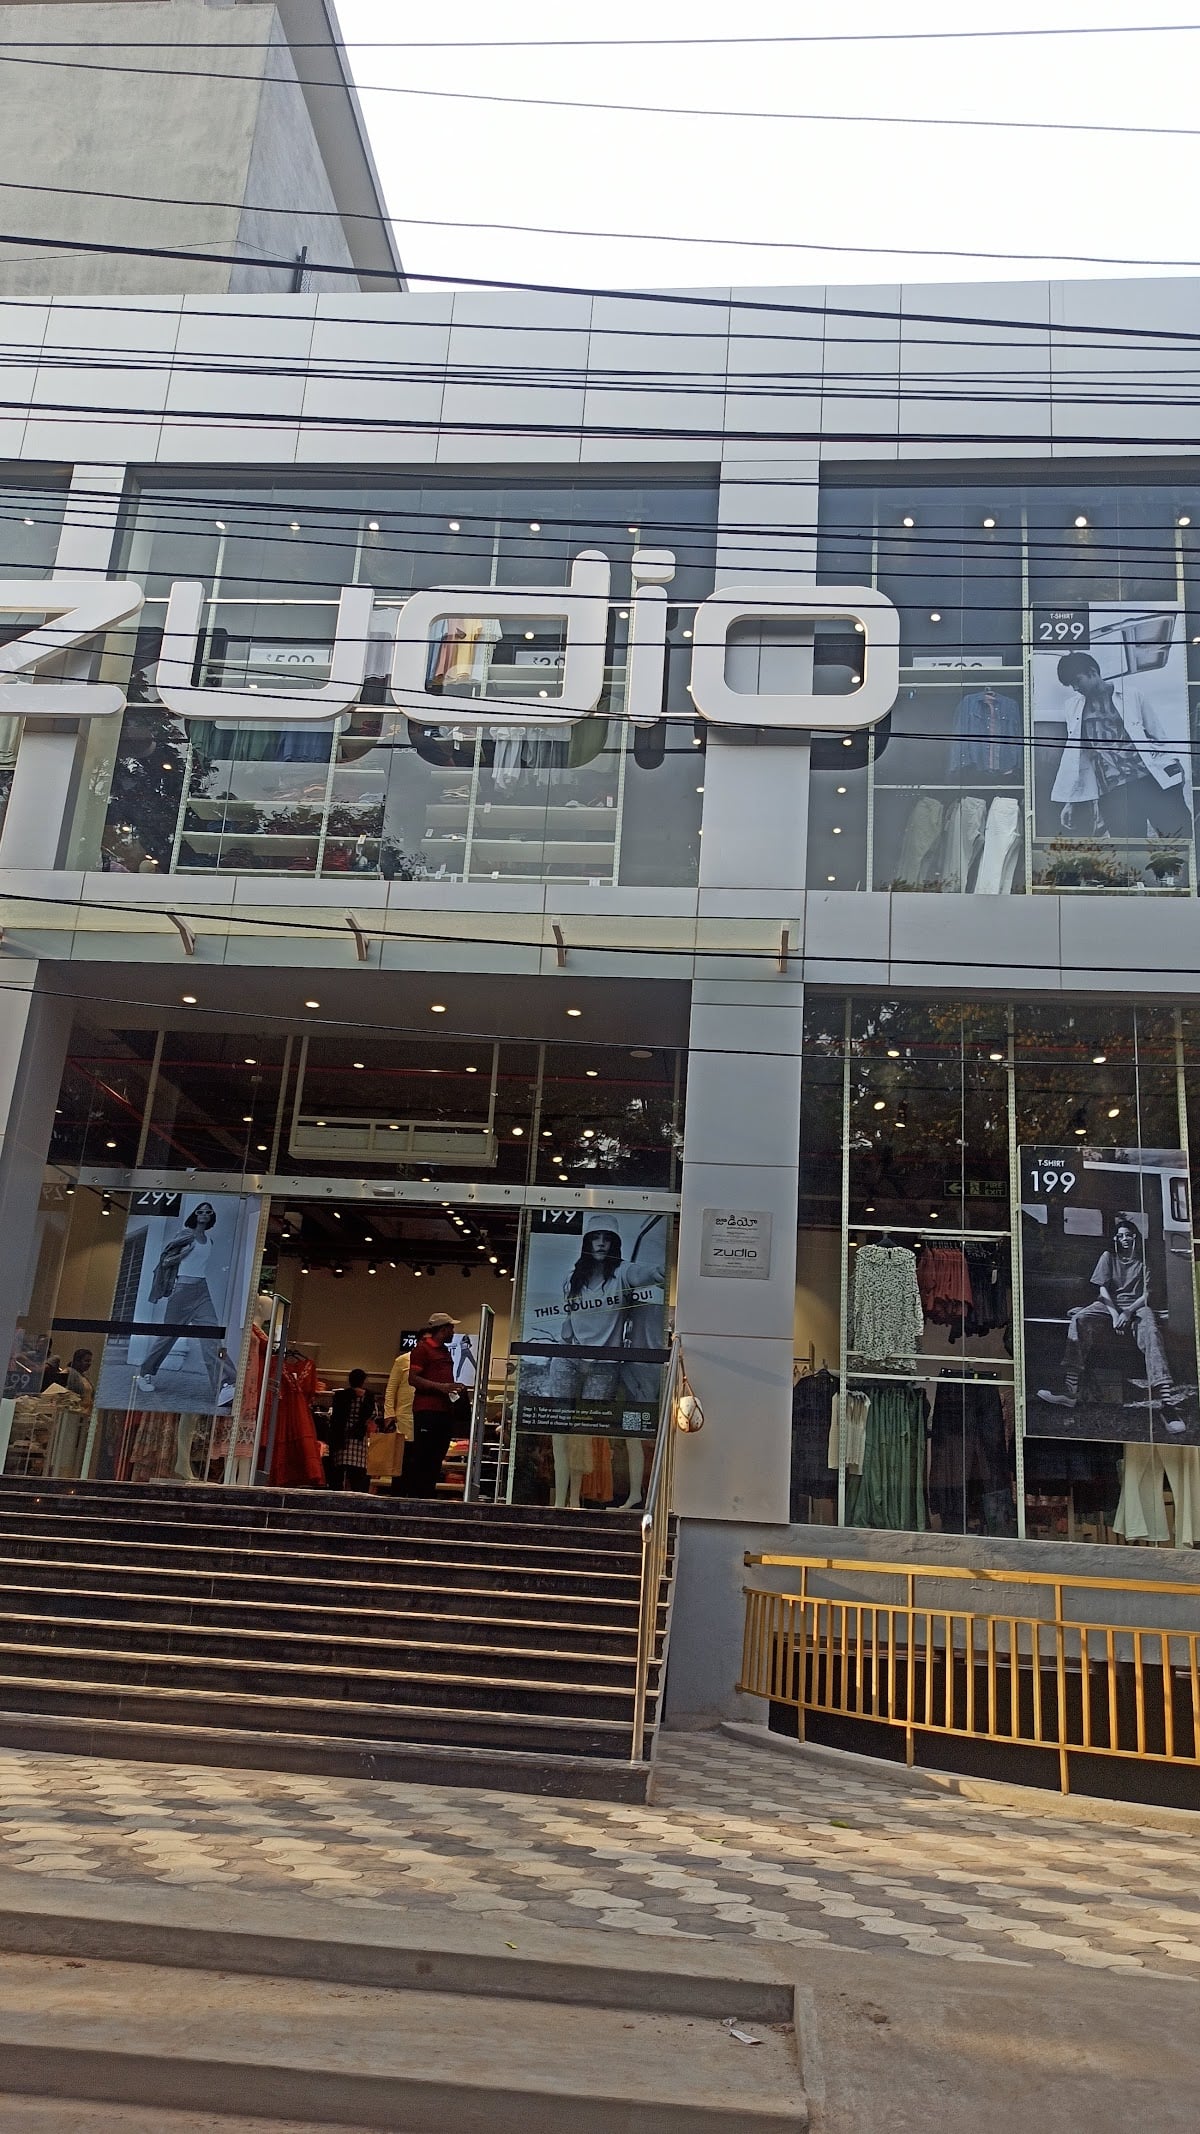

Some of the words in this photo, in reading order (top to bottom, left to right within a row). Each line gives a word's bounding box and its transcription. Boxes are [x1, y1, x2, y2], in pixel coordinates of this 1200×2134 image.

[1039, 622, 1085, 641] 299
[1038, 1159, 1065, 1168] T-SHIRT
[1031, 1170, 1076, 1194] 199
[136, 1191, 178, 1206] 299
[542, 1209, 577, 1224] 199
[534, 1305, 560, 1319] THIS
[563, 1298, 603, 1314] COULD
[606, 1295, 621, 1307] BE
[623, 1289, 653, 1302] YOU!
